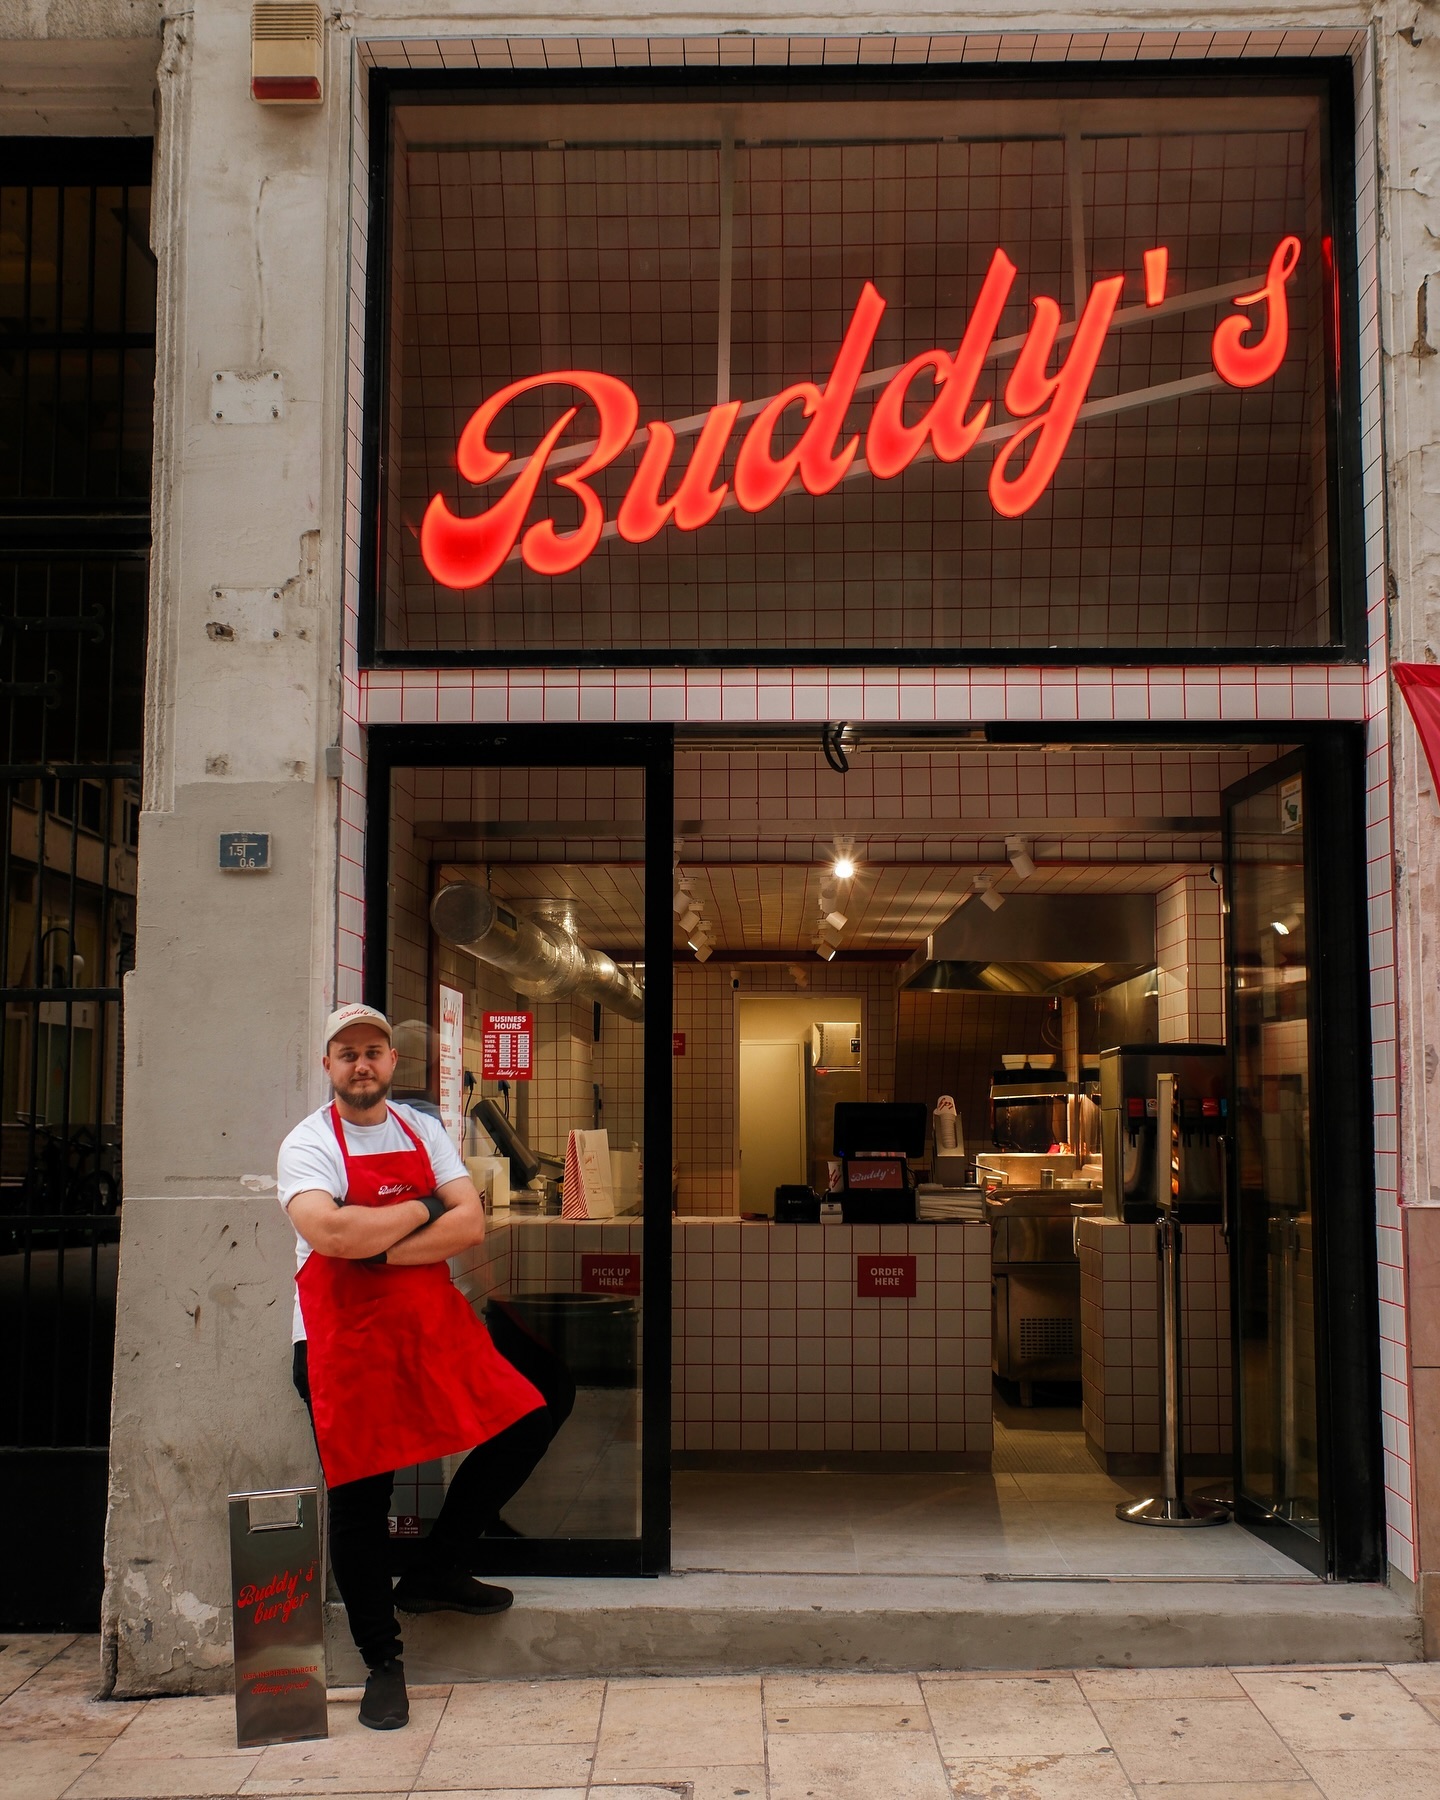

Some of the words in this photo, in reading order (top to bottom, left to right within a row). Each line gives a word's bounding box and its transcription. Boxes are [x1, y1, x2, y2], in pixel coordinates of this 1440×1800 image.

[420, 235, 1302, 590] Buddy's
[228, 846, 243, 856] 1.5
[239, 857, 256, 868] 0.6
[850, 1168, 896, 1183] Buddy's
[378, 1184, 412, 1196] Buddy's
[592, 1268, 615, 1276] PICK
[617, 1268, 631, 1276] UP
[870, 1268, 904, 1276] ORDER
[598, 1277, 624, 1286] HERE
[874, 1277, 900, 1286] HERE
[237, 1566, 315, 1609] Buddy's
[253, 1592, 310, 1625] burger
[256, 1669, 289, 1679] INSPIRED
[290, 1665, 318, 1675] BURGER
